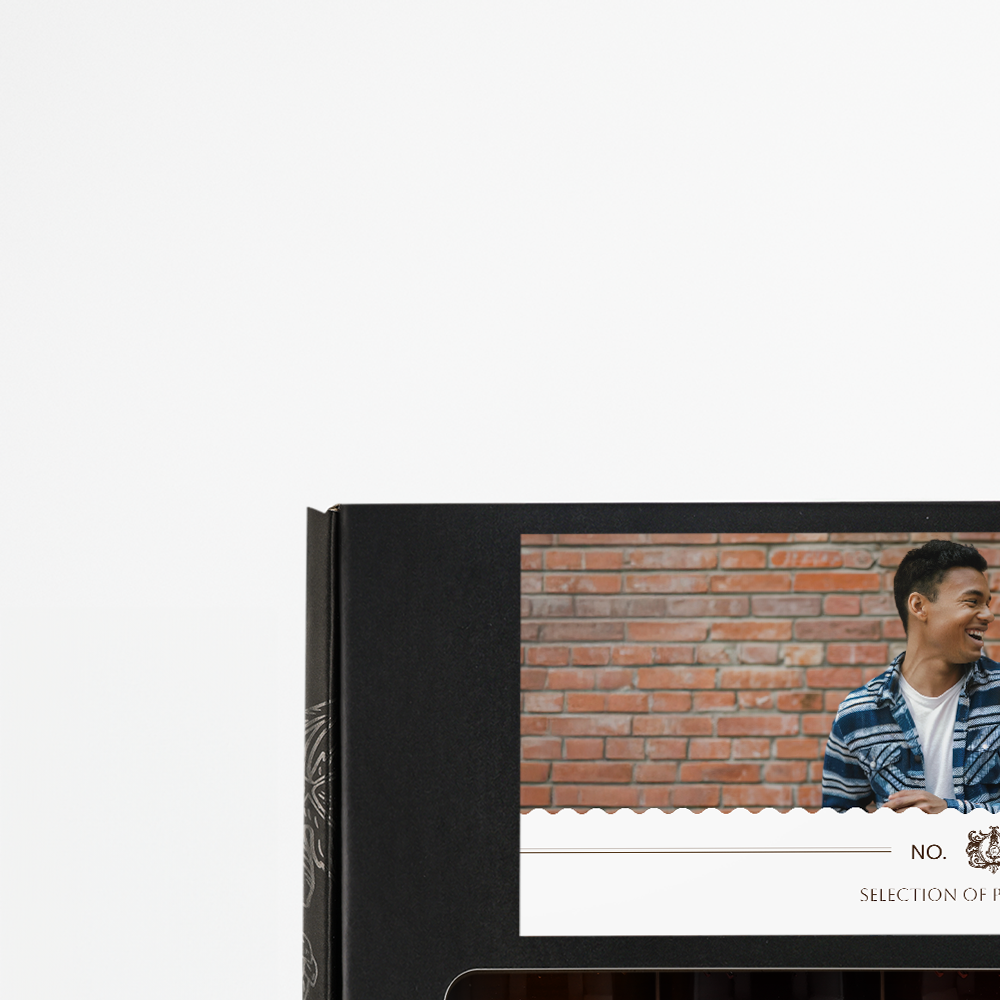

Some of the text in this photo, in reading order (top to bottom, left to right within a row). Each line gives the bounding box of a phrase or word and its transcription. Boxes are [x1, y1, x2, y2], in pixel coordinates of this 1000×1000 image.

[911, 844, 947, 859] NO.
[860, 887, 957, 902] SELECTION
[963, 887, 987, 902] OF
